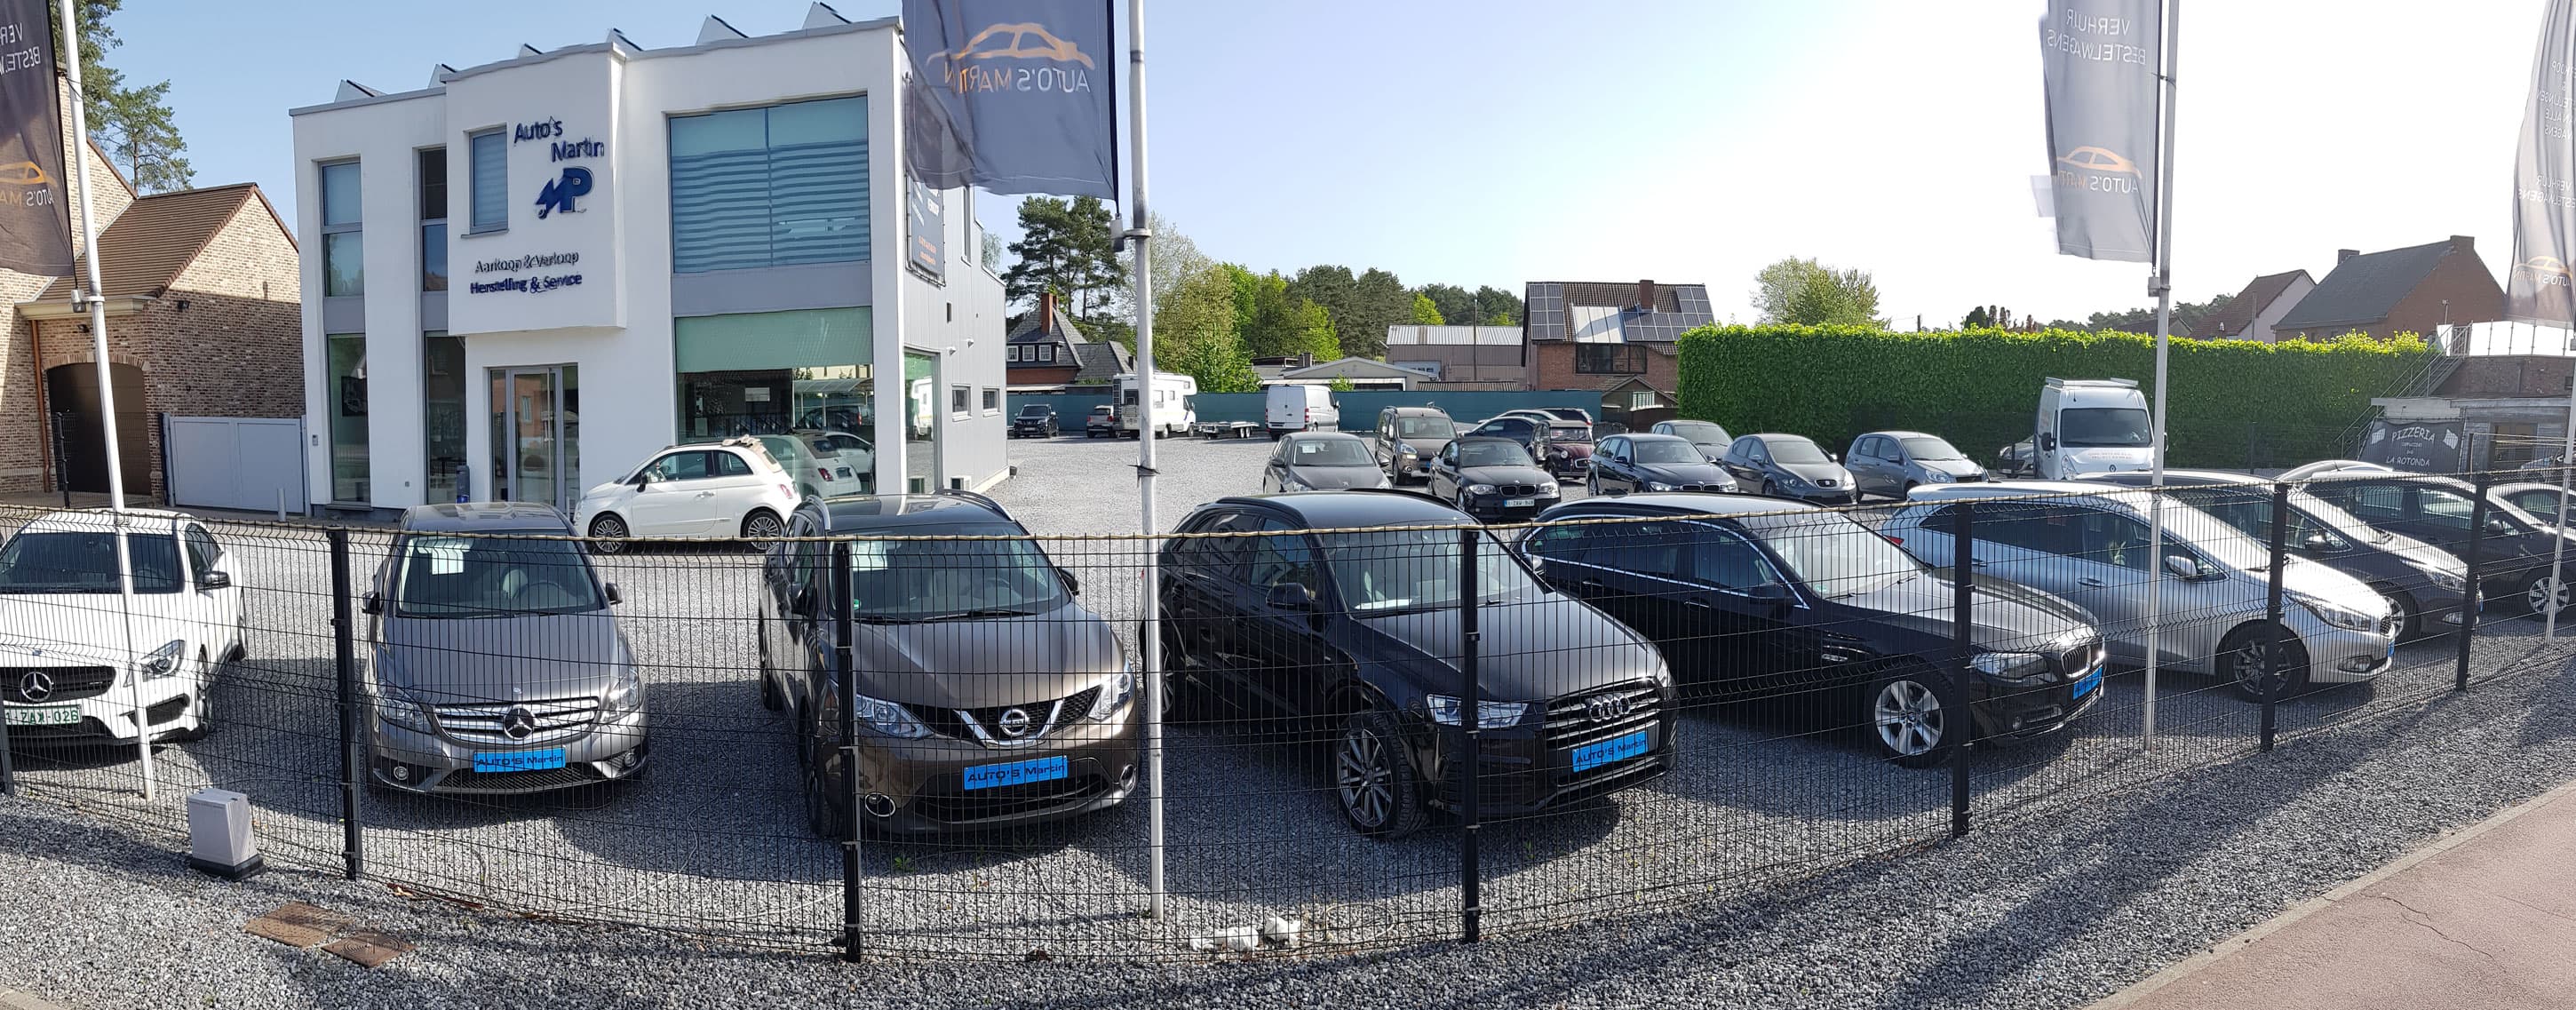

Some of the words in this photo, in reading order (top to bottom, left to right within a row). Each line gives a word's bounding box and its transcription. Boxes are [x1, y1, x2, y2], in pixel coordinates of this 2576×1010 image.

[551, 138, 605, 162] Martin
[2391, 426, 2436, 444] PIZZERIA
[2397, 457, 2430, 466] ROTONDA
[478, 757, 524, 767] AUTO'S
[527, 754, 564, 764] Martin
[1576, 746, 1615, 764] AUTO'S
[967, 768, 1021, 783] AUTO'S
[1025, 763, 1065, 775] Martin
